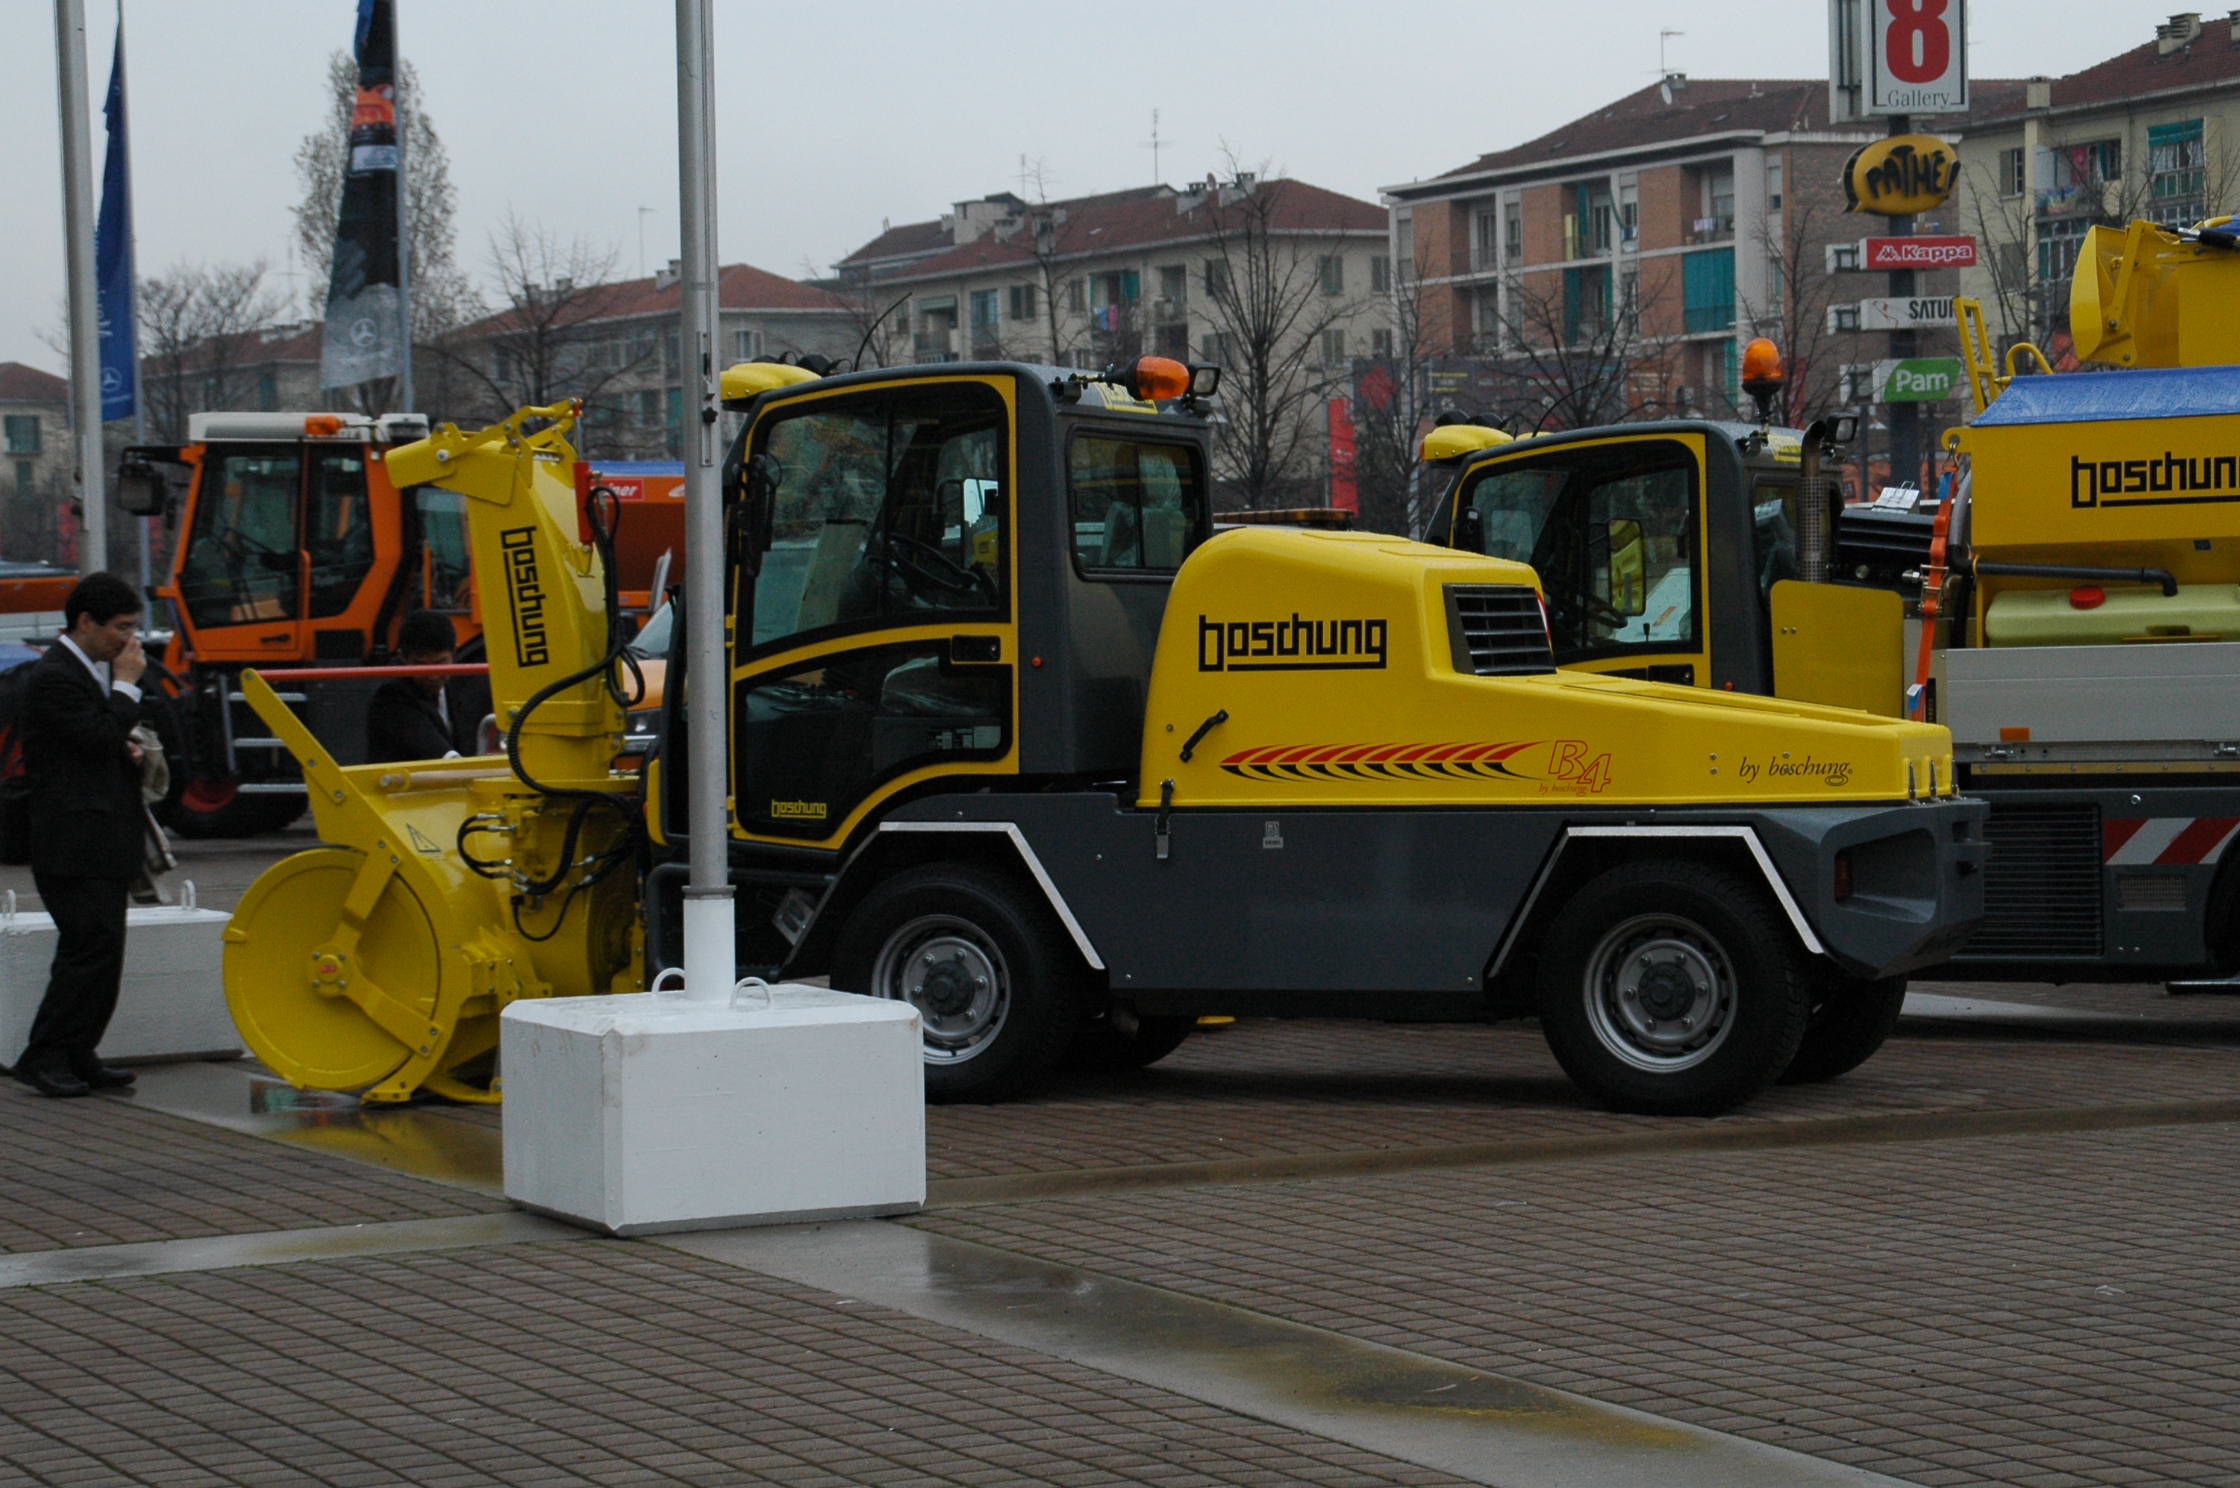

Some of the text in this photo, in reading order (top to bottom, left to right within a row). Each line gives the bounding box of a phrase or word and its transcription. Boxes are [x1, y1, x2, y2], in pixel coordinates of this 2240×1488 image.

[1886, 0, 1950, 84] 8
[1887, 89, 1950, 109] Gallery
[1903, 245, 1973, 262] Kappa
[1896, 369, 1949, 393] Pam
[2072, 451, 2240, 508] boschun
[501, 525, 549, 668] boschung
[1199, 613, 1387, 672] boschung
[1548, 740, 1612, 793] B4
[1738, 757, 1760, 784] by
[771, 798, 827, 819] boschung
